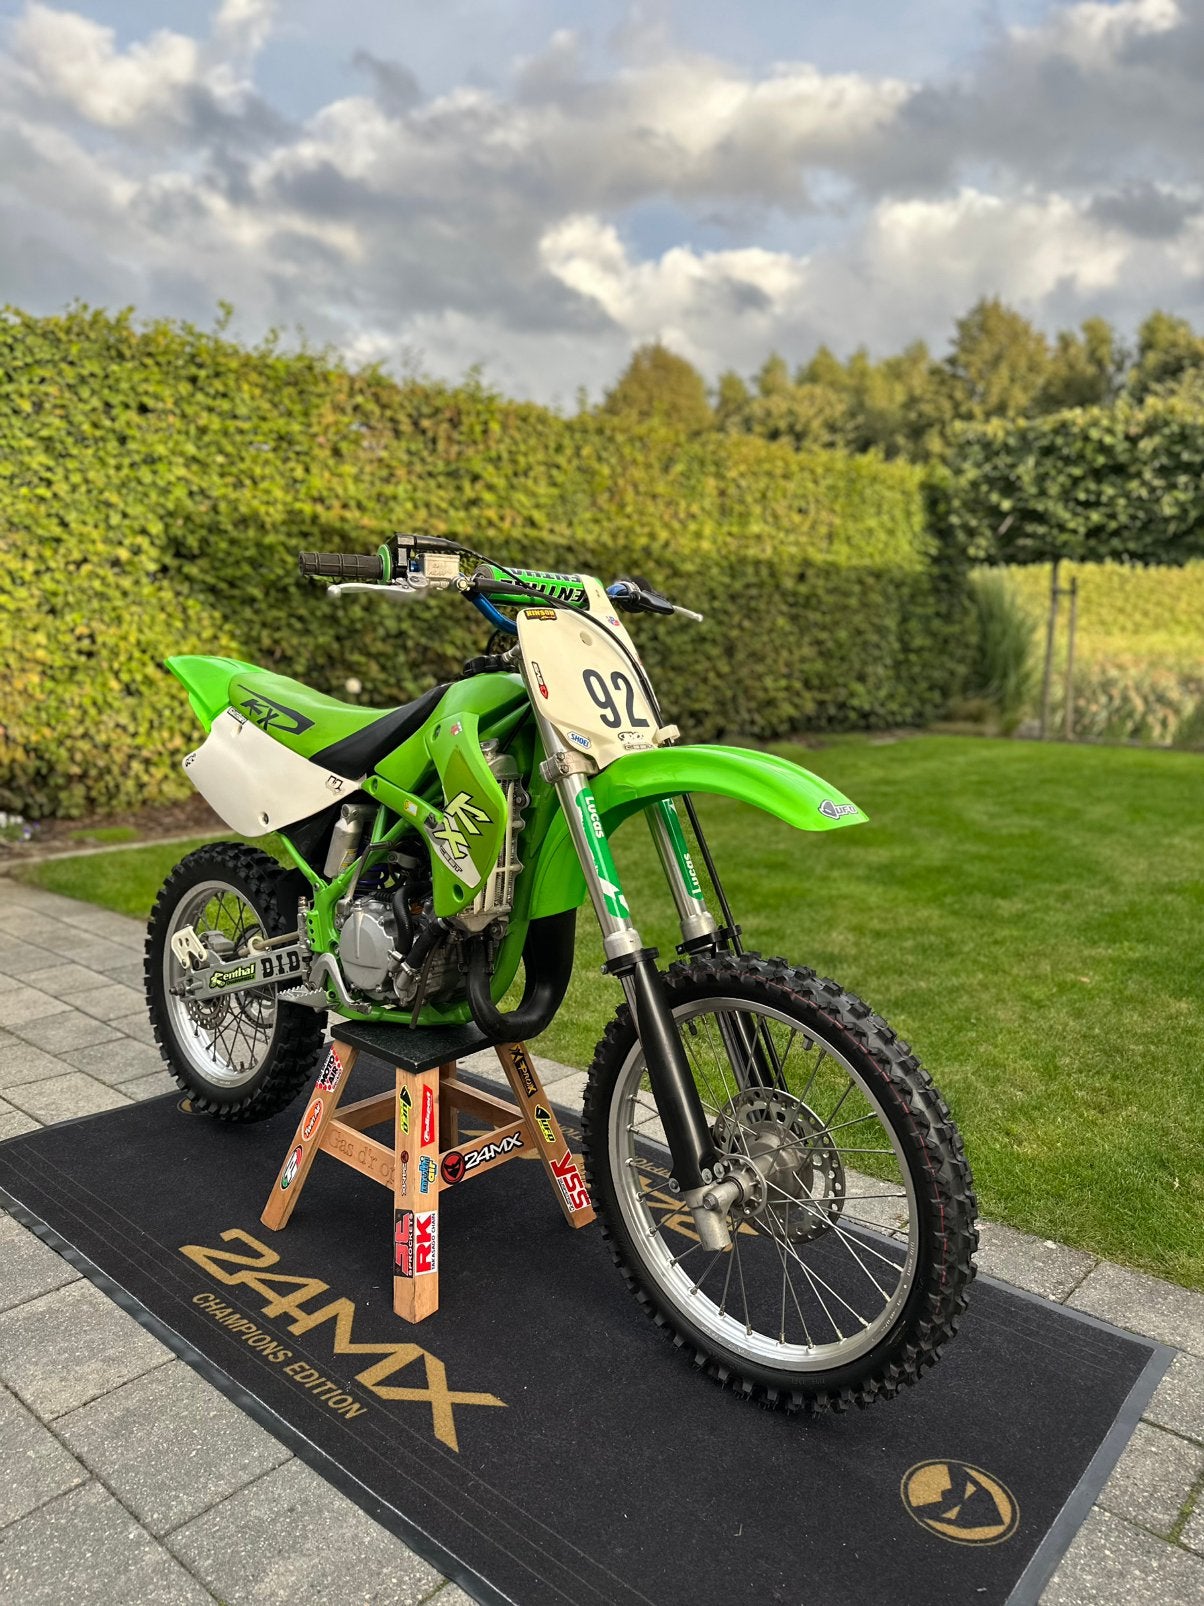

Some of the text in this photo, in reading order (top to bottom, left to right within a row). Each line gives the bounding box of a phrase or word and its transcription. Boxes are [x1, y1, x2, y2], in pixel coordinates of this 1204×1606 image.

[583, 669, 650, 728] 92
[571, 733, 589, 748] SHOEI
[432, 790, 494, 860] KX
[209, 963, 255, 988] Renthal
[321, 1055, 335, 1084] MOTO
[328, 1066, 338, 1085] AIR
[329, 1128, 354, 1157] Gas
[464, 1132, 523, 1169] 24MX
[550, 1151, 591, 1210] YSS
[416, 1214, 431, 1273] RK
[178, 1228, 508, 1453] 24MX
[192, 1293, 367, 1419] CHAMPIONS EDITION
